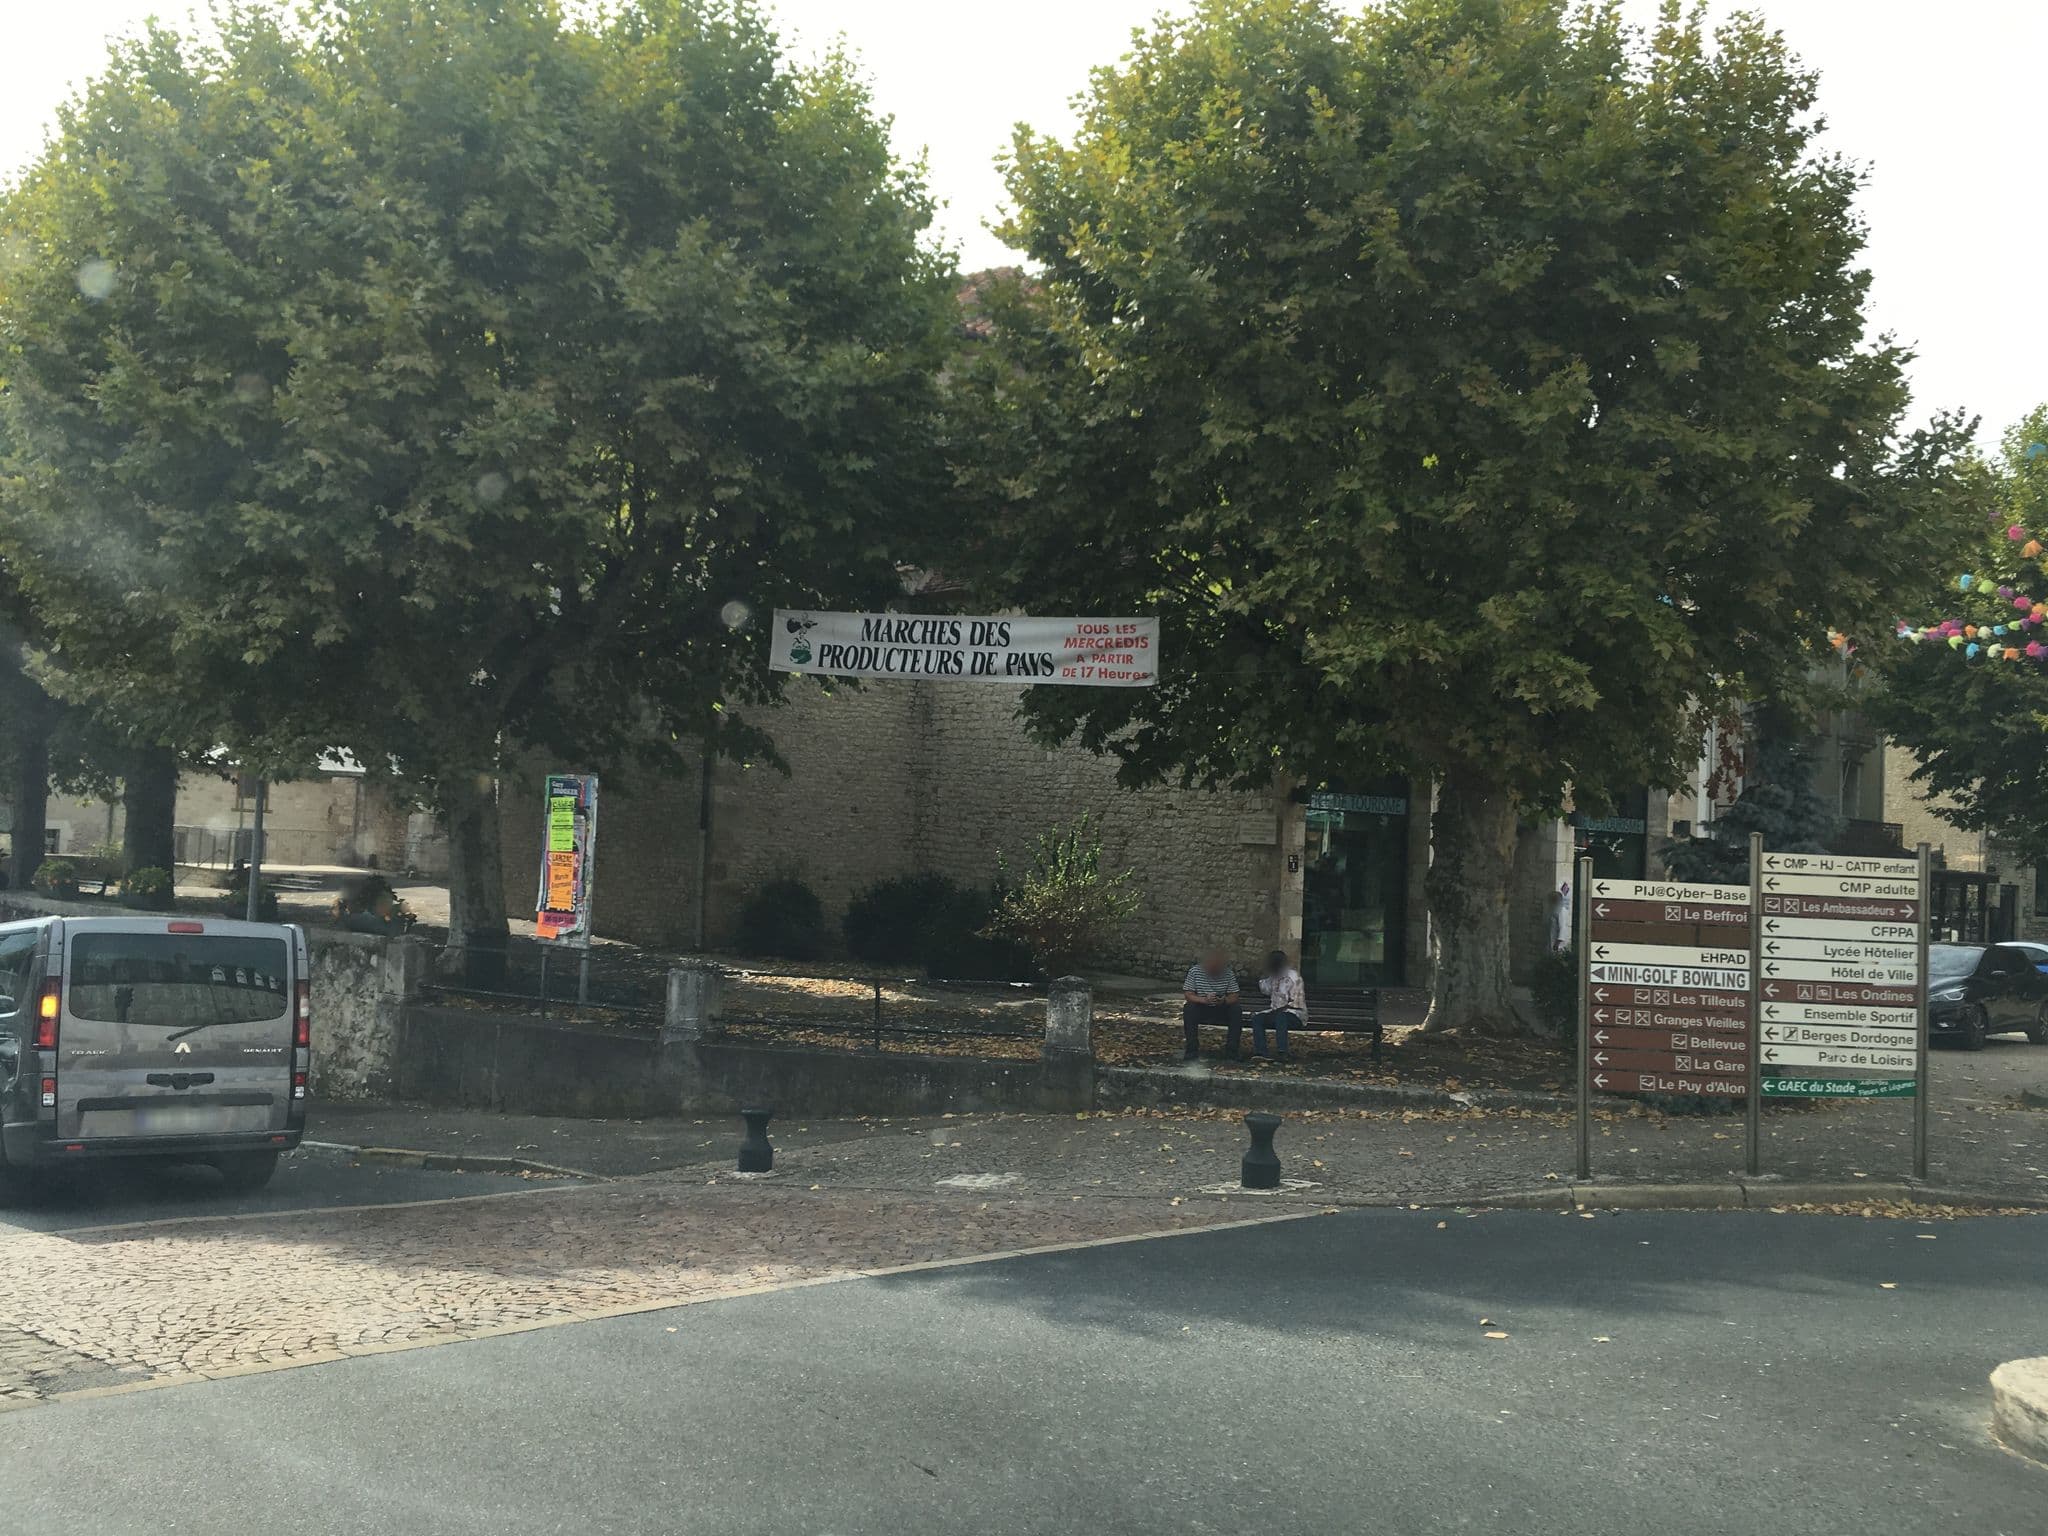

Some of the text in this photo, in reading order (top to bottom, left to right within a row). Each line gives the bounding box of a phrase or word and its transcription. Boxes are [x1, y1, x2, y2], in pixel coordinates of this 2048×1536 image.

[861, 618, 1011, 647] MARCHES DES
[1077, 623, 1137, 635] TOUS LES
[1064, 635, 1149, 650] MERCREDIS
[818, 644, 1055, 678] PRODUCTEURS DE PAYS
[1076, 654, 1134, 665] A PARTIR
[1062, 667, 1150, 681] DE 17 Heures
[1783, 858, 1808, 870] CMP
[1820, 860, 1834, 871] HJ
[1846, 861, 1881, 873] CATTP
[1883, 863, 1915, 874] enfant
[1839, 882, 1915, 896] CMP adulte
[1684, 908, 1748, 923] Le Beffroi
[1802, 902, 1895, 917] Les Ambassadeurs
[1871, 926, 1914, 938] CFPPA
[1701, 952, 1746, 965] EHPAD
[1824, 945, 1914, 959] Lycée Hôtelier
[1608, 966, 1746, 988] MINI-GOLF BOWLING
[1831, 966, 1914, 981] Hôtel de Ville
[1673, 993, 1746, 1008] Les Tilleuls
[1834, 988, 1914, 1002] Les Ondines
[1654, 1014, 1746, 1029] Granges Vieilles
[1803, 1008, 1914, 1025] Ensemble Sportif
[1690, 1037, 1746, 1050] Bellevue
[1802, 1030, 1914, 1047] Berges Dordogne
[1694, 1059, 1745, 1072] La Gare
[1818, 1051, 1913, 1066] Parc de Loisirs
[1659, 1078, 1746, 1094] Le Puy d'Alon
[1777, 1081, 1809, 1092] GAEC
[1809, 1081, 1824, 1092] du
[1825, 1082, 1856, 1093] Stade
